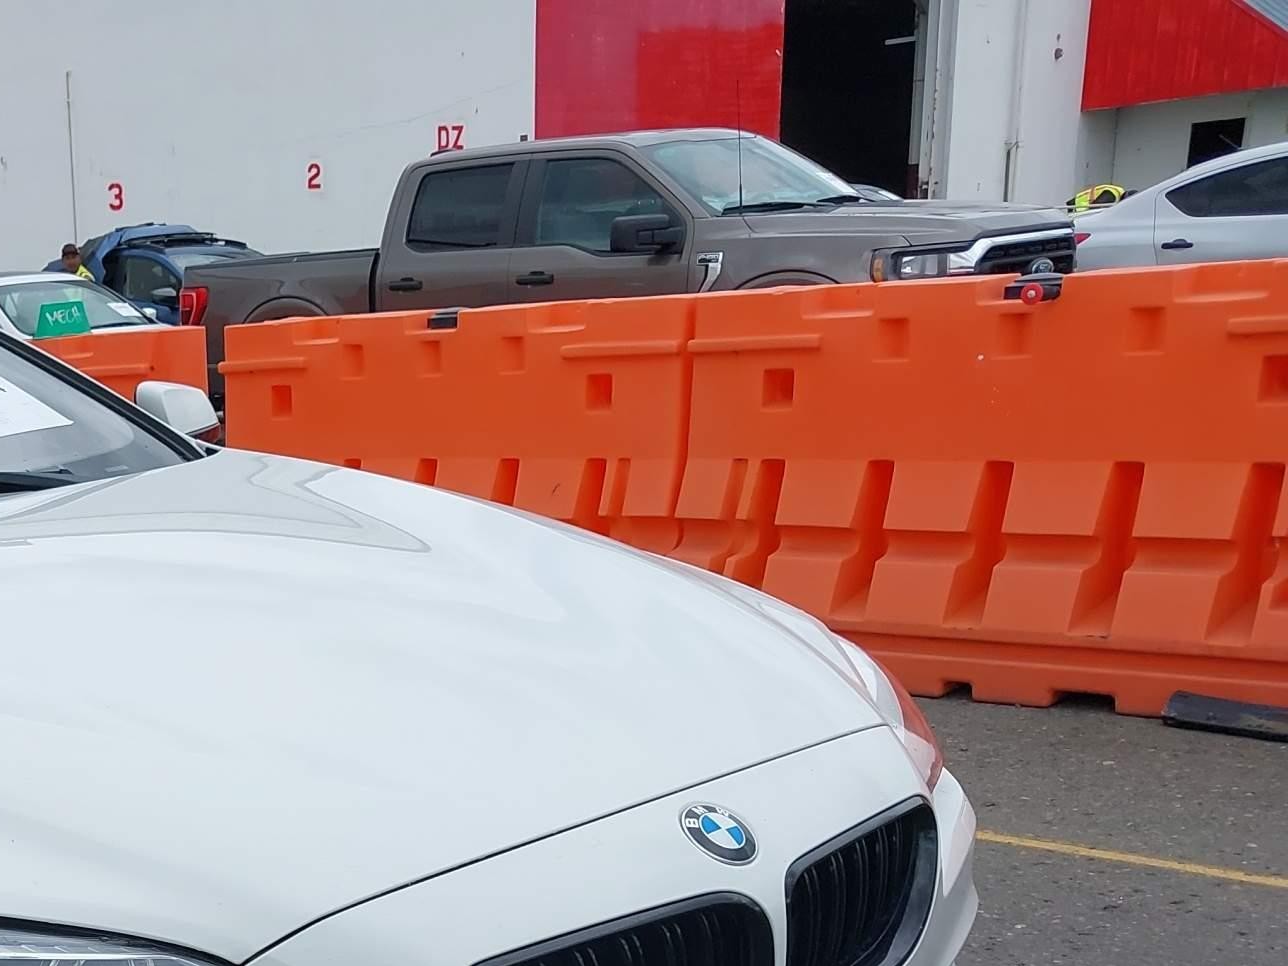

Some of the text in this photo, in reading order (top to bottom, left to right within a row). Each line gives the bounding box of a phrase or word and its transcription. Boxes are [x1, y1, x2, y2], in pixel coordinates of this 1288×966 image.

[437, 125, 464, 150] DZ
[308, 163, 321, 189] 2
[108, 183, 123, 211] 3
